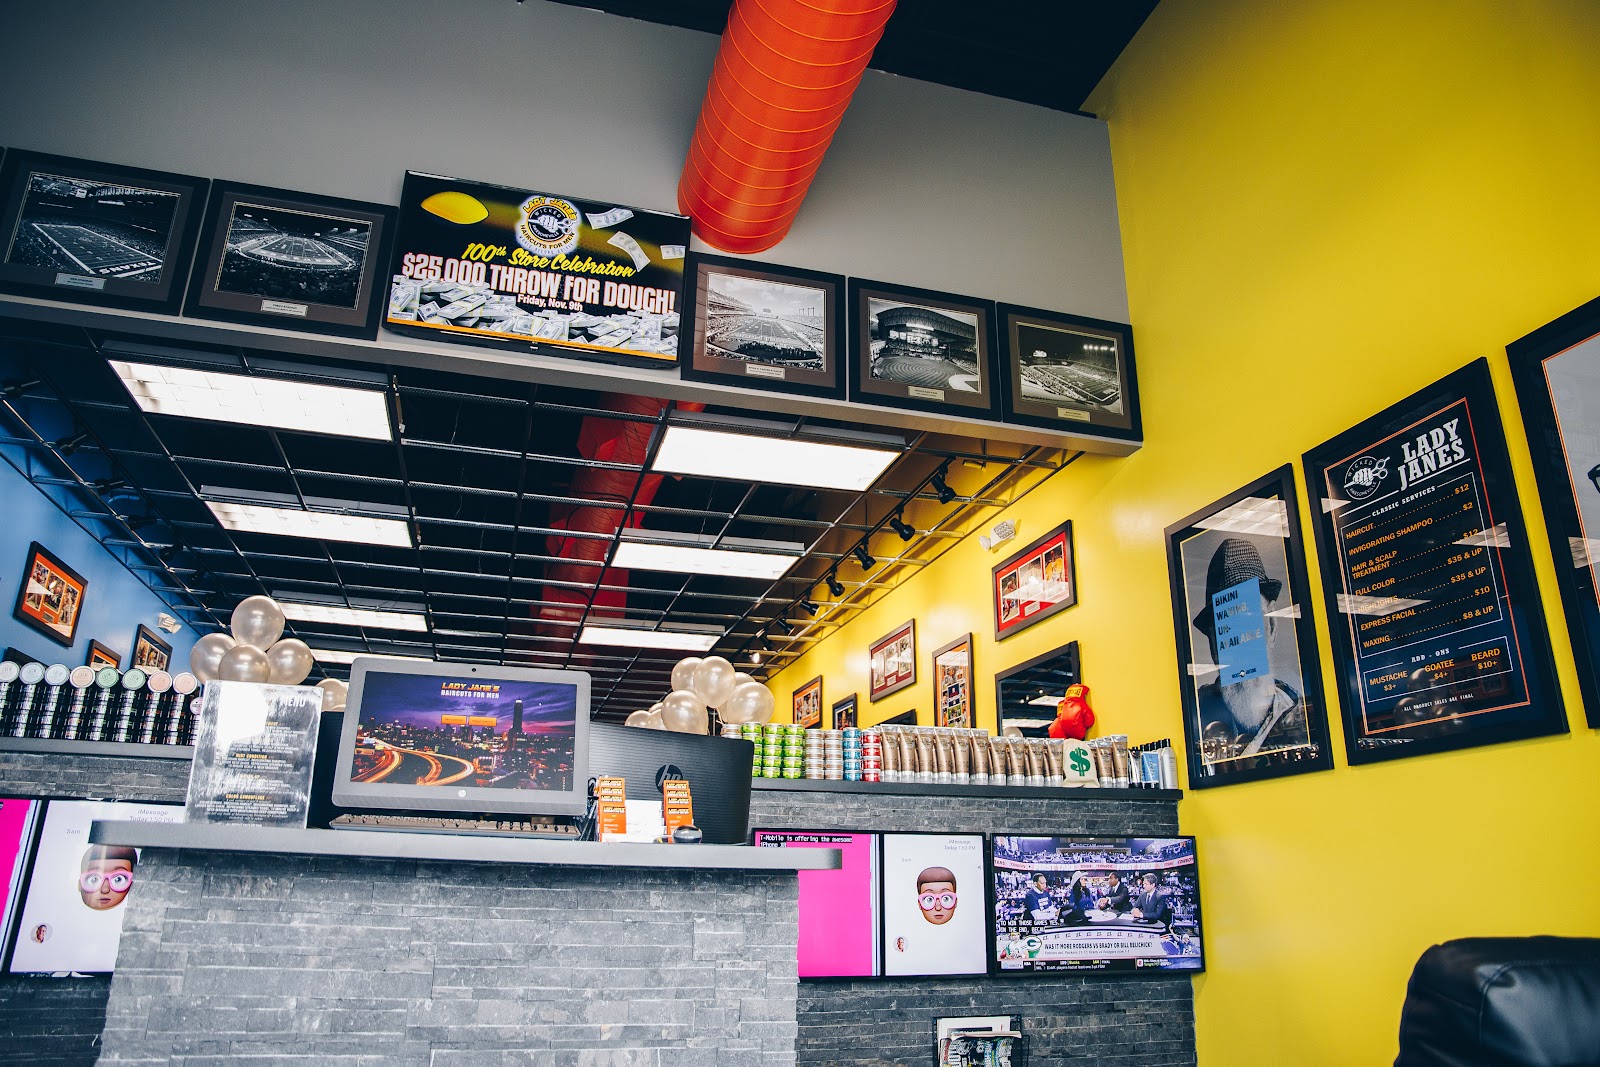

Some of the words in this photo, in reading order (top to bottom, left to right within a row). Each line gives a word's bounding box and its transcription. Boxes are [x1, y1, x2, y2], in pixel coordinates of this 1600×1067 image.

[520, 224, 547, 249] HAIRCUTS
[563, 232, 575, 245] MEN
[461, 243, 507, 262] 100th
[508, 248, 551, 269] Store
[551, 253, 636, 278] Celebration
[402, 252, 487, 287] $25,000
[490, 264, 561, 299] THROW
[563, 275, 600, 305] FOR
[603, 281, 676, 314] DOUGH!
[518, 293, 546, 307] Friday,
[548, 298, 567, 309] Nov.
[569, 300, 583, 312] 9th
[1401, 418, 1459, 463] LADY
[1348, 460, 1373, 477] WICKED
[1398, 438, 1465, 491] JANES
[1372, 501, 1400, 517] CLASSIC
[1402, 486, 1436, 505] SERVICES
[1346, 523, 1374, 539] HAIRCUT
[1455, 484, 1469, 494] $12
[1349, 533, 1396, 556] INVIGORATING
[1396, 518, 1433, 537] SHAMPOO
[1463, 502, 1473, 511] $2
[1351, 562, 1367, 572] HAIR
[1375, 551, 1397, 564] SCALP
[1352, 561, 1391, 579] TREATMENT
[1355, 587, 1371, 596] FULL
[1371, 578, 1396, 591] COLOR
[1447, 554, 1463, 565] $35
[1471, 548, 1482, 557] UP
[1215, 590, 1238, 607] BIKINI
[1357, 595, 1399, 613] HIGHLIGHTS
[1450, 573, 1466, 583] $35
[1475, 566, 1486, 575] UP
[1360, 616, 1391, 631] EXPRESS
[1391, 609, 1417, 621] FACIAL
[1474, 586, 1490, 596] $10
[1363, 634, 1390, 648] WAXING
[1475, 609, 1481, 617] &
[1483, 605, 1494, 614] UP
[1411, 655, 1426, 663] ADD
[1435, 648, 1450, 656] ONS
[1471, 648, 1500, 661] BEARD
[1424, 659, 1454, 673] GOATEE
[1477, 660, 1497, 670] $10+
[1369, 670, 1408, 686] MUSTACHE
[1433, 671, 1448, 680] $4+
[441, 682, 467, 691] LADY
[467, 683, 500, 692] JANE'S
[1384, 683, 1396, 691] $3+
[1460, 693, 1474, 701] FINAL
[760, 834, 784, 842] T-Mobile
